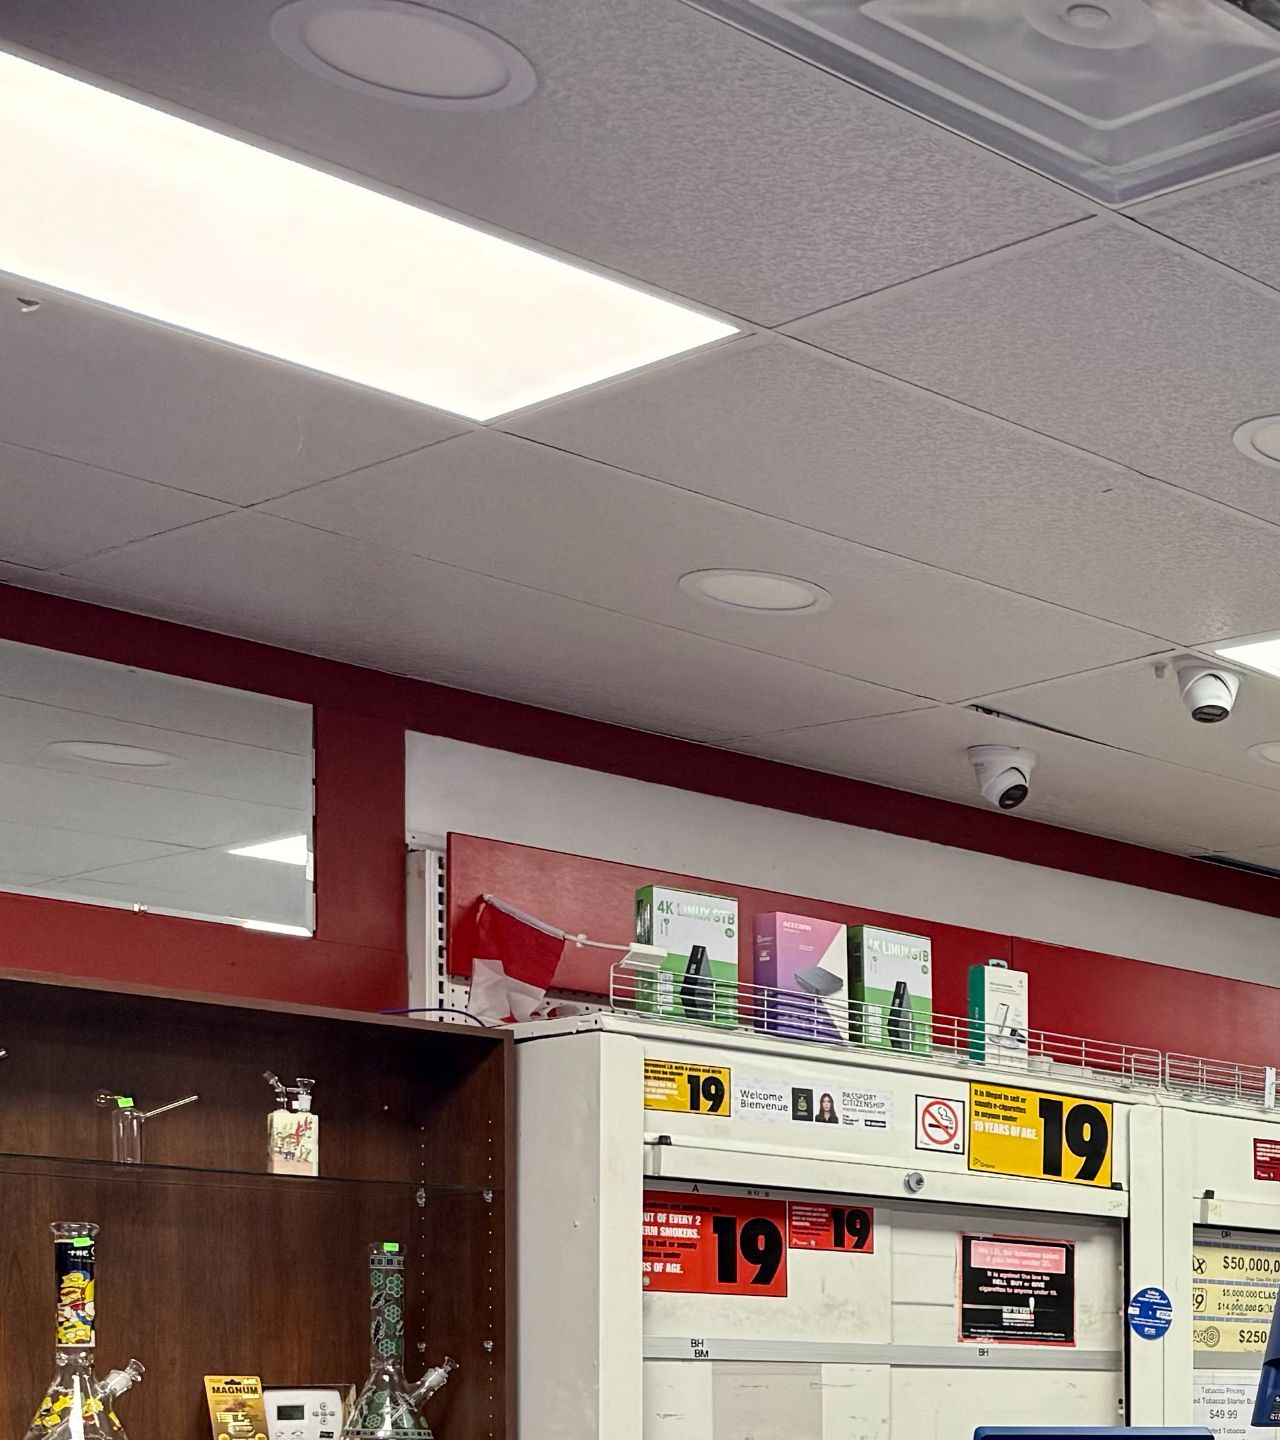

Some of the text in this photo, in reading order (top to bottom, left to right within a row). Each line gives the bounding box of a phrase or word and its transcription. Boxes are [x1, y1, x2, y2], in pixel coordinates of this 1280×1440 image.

[686, 1075, 726, 1113] 19
[740, 1090, 783, 1102] Welcome
[842, 1091, 878, 1102] PASSPORT
[740, 1099, 789, 1112] Bienvenue
[842, 1099, 886, 1109] CITIZENSHIP
[984, 1122, 1010, 1136] YEARS
[1010, 1125, 1020, 1137] OF
[1020, 1127, 1039, 1140] AGE.
[1038, 1097, 1109, 1181] 19
[691, 1184, 699, 1193] A
[656, 1213, 667, 1224] OF
[668, 1214, 694, 1225] EVERY
[660, 1228, 701, 1239] SMOKERS.
[831, 1207, 871, 1250] 19
[712, 1215, 784, 1286] 19
[653, 1262, 664, 1273] OF
[1238, 1330, 1267, 1344] $250
[690, 1338, 704, 1348] BH
[694, 1348, 709, 1358] BM
[211, 1386, 259, 1395] MAGNUM
[1201, 1386, 1245, 1396] Tobacco Pricing
[1202, 1397, 1226, 1405] Tobacco
[1223, 1427, 1246, 1435] Tobacco
